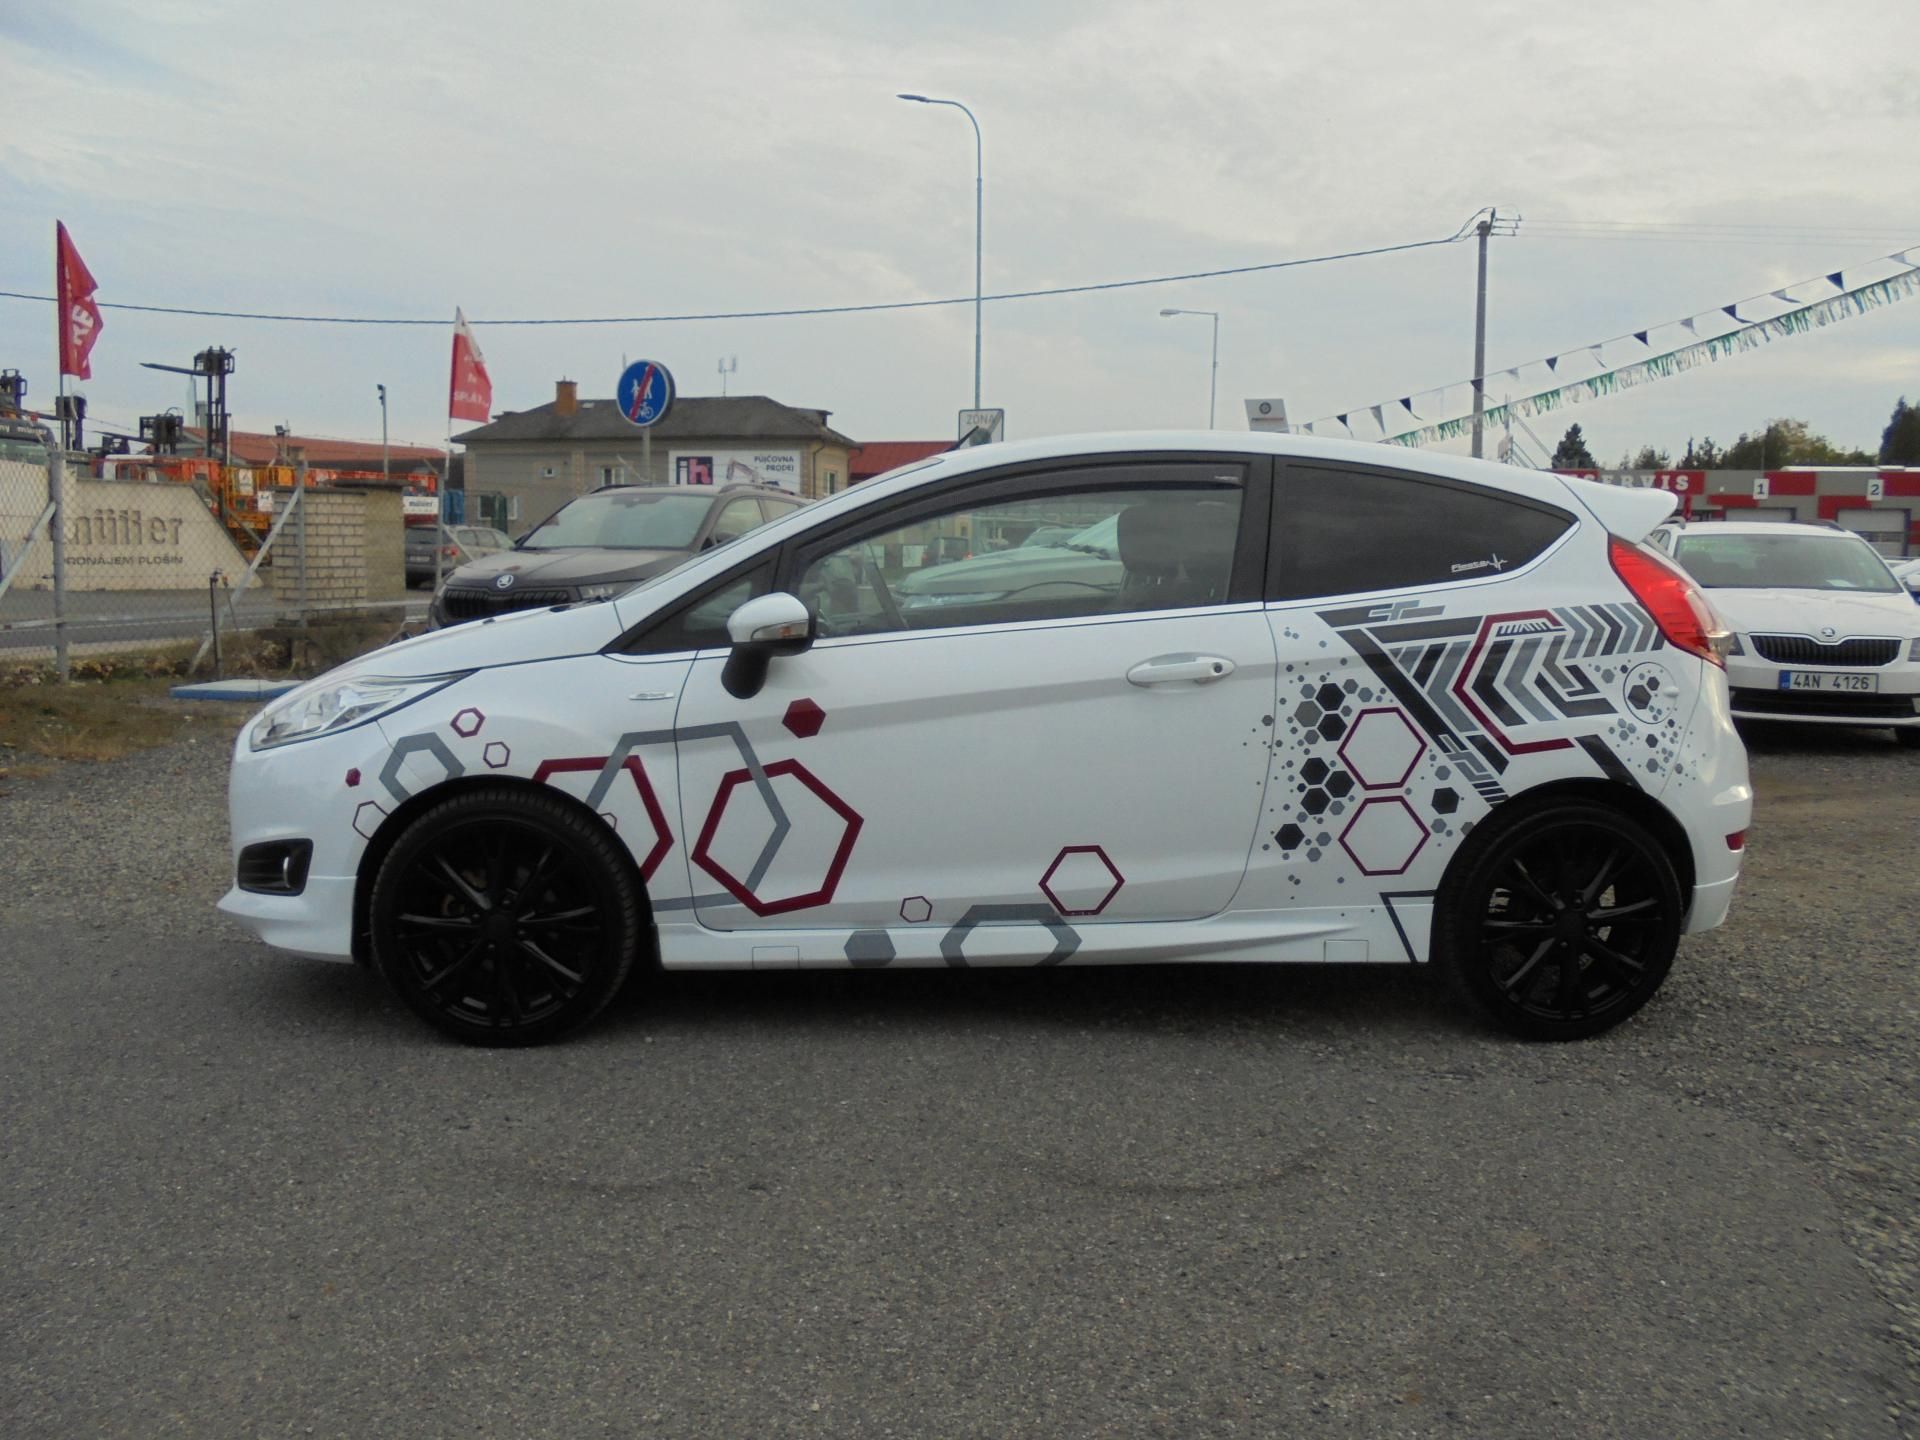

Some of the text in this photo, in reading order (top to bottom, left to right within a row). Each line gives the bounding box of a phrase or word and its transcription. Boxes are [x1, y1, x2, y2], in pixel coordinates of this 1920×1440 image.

[766, 464, 794, 472] PRODEJ
[1757, 483, 1765, 495] 1
[1870, 484, 1881, 496] 2
[1793, 674, 1820, 688] 4AN
[1832, 676, 1869, 690] 4126
